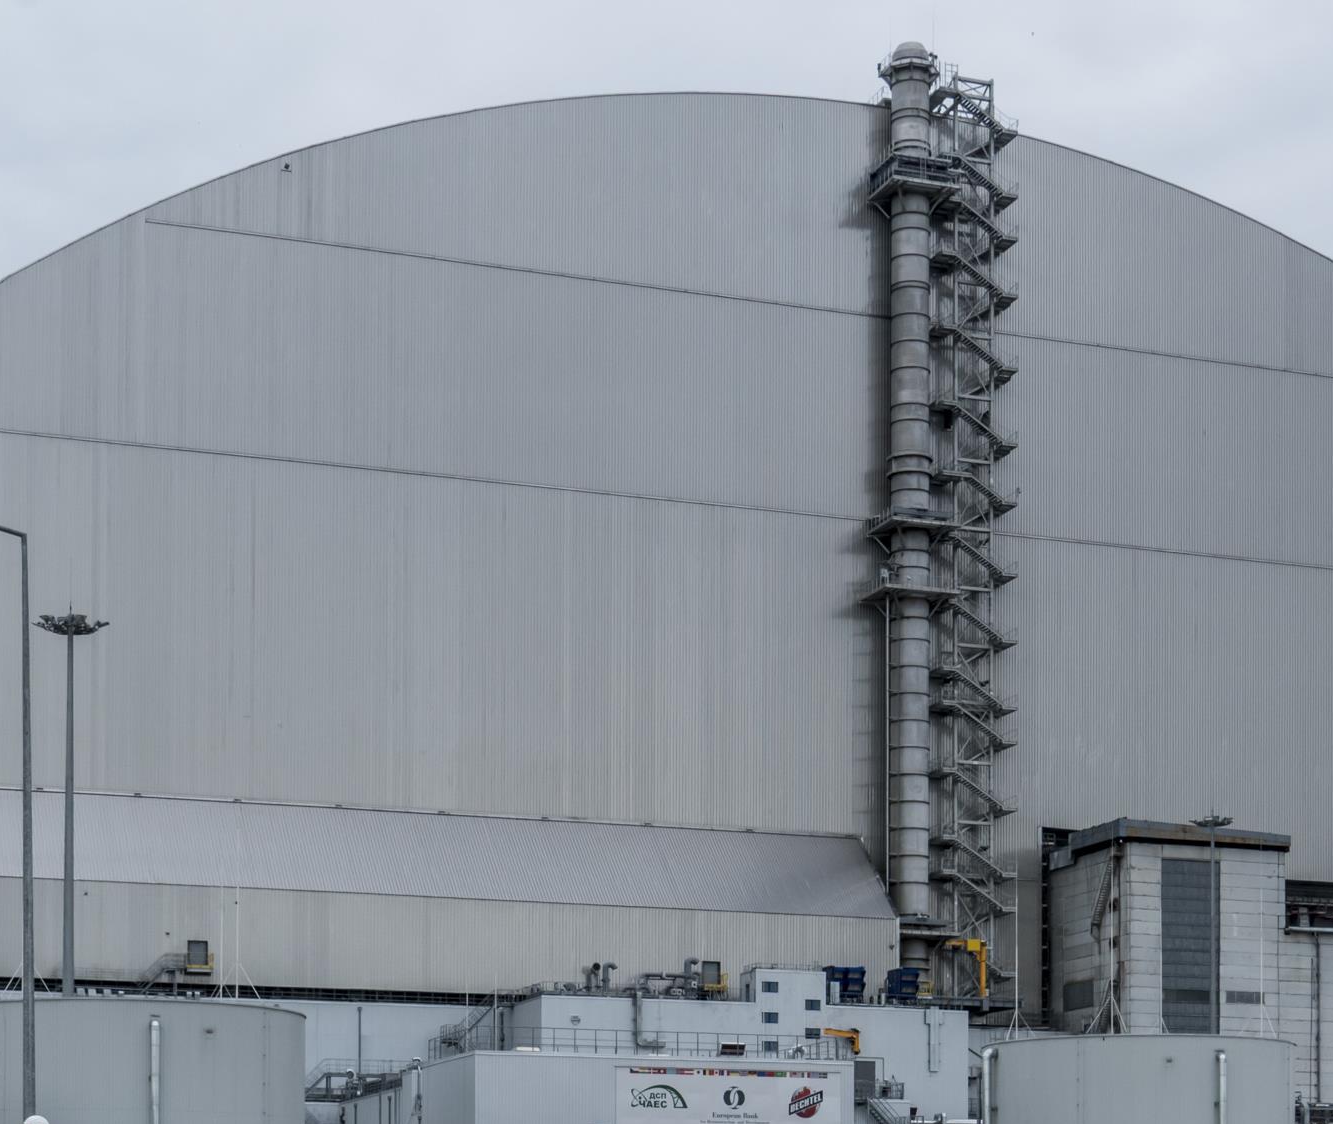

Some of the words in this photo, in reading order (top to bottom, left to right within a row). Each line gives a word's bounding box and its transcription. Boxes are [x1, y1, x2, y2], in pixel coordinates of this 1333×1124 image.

[649, 1092, 667, 1100] ДСП
[638, 1100, 668, 1108] ЧАЕС
[790, 1092, 821, 1113] BECHTEL
